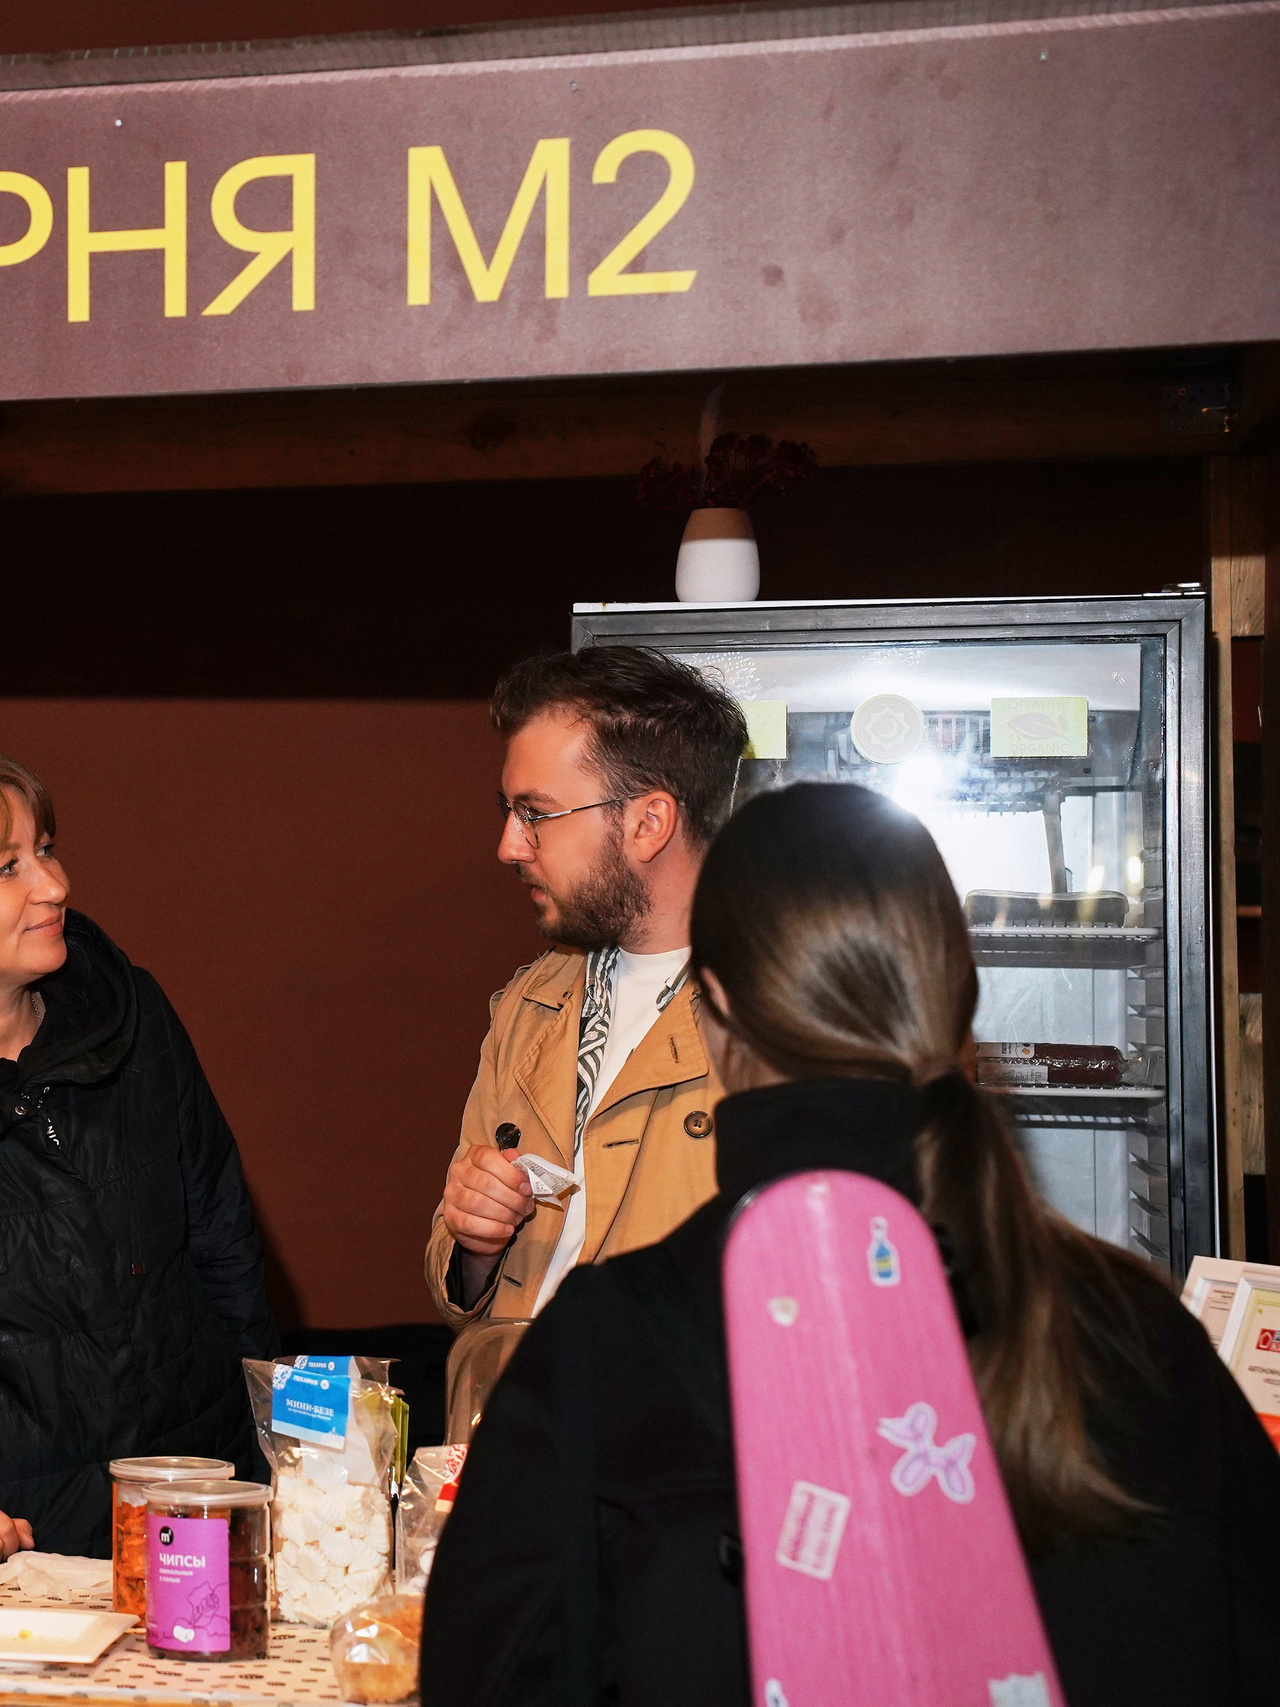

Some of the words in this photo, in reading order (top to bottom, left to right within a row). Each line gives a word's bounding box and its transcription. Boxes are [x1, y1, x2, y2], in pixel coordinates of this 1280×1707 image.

[405, 128, 698, 307] М2
[1008, 743, 1069, 754] ORGANIC
[286, 1398, 335, 1418] МИНИ-БЕЗЕ
[159, 1553, 206, 1568] ЧИПСЫ
